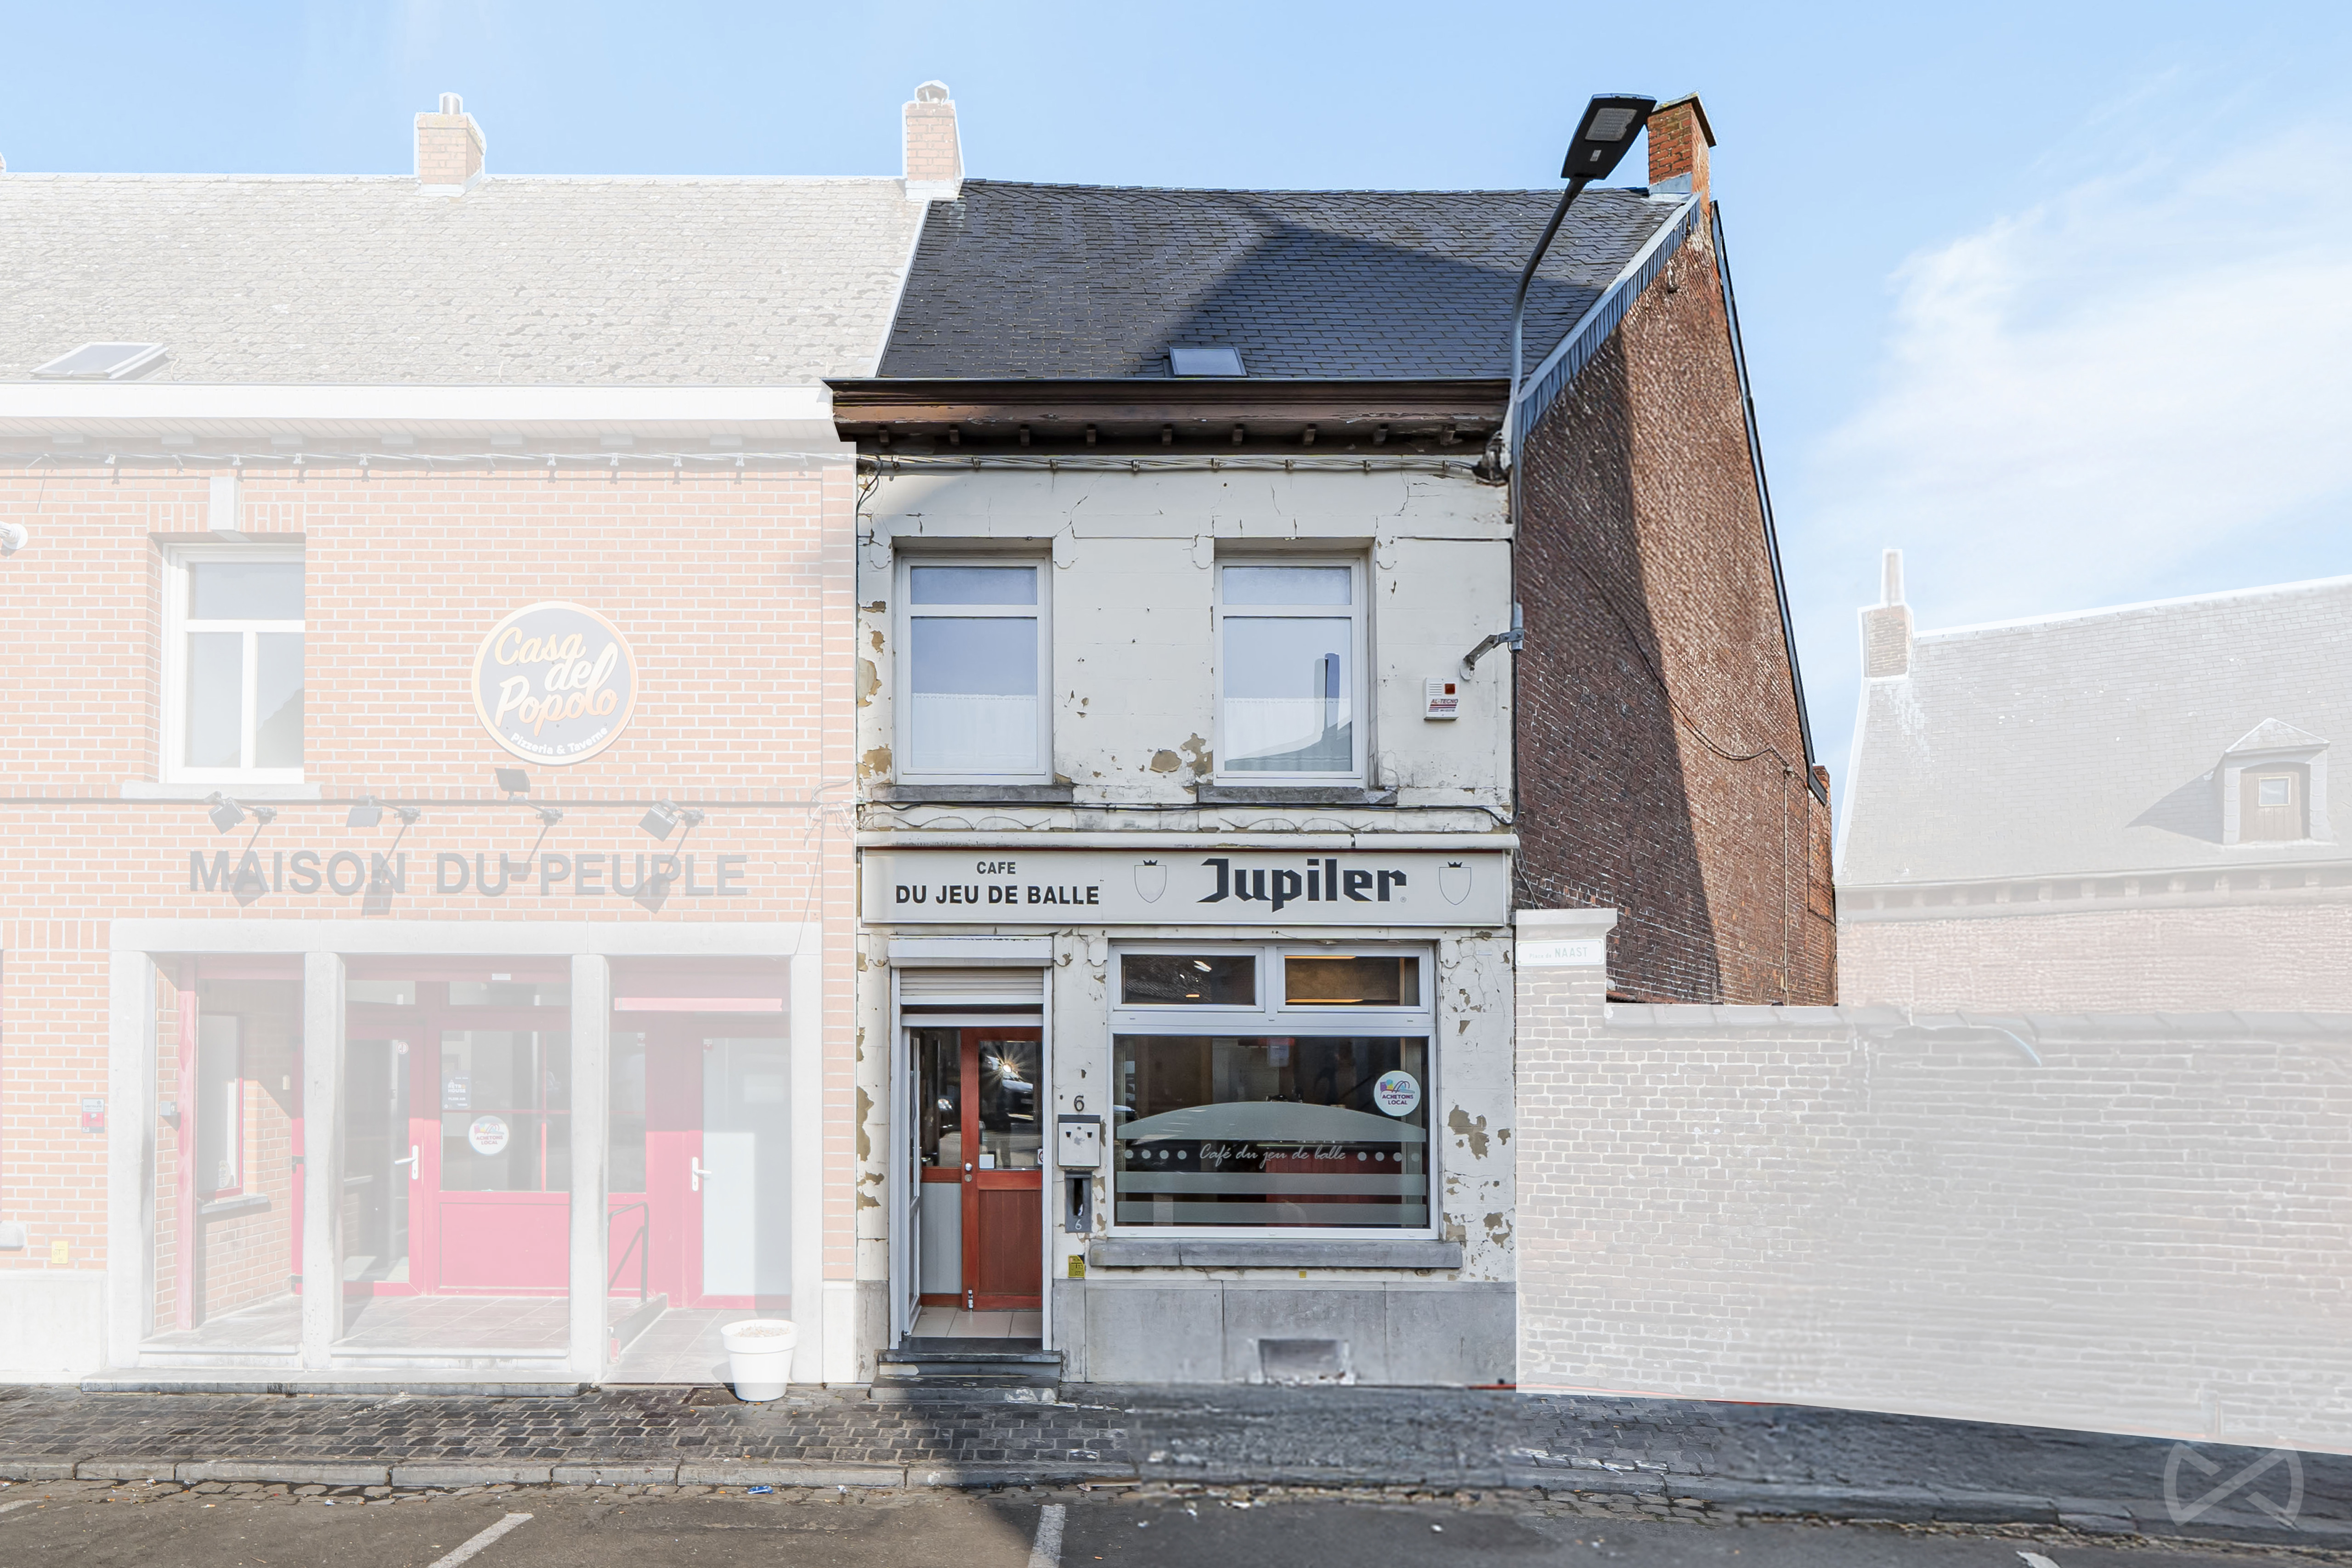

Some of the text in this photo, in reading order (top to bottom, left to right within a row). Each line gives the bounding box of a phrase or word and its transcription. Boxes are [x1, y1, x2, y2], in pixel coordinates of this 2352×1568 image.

[495, 627, 587, 665] Casa
[544, 642, 618, 691] del
[495, 675, 619, 737] Popolo
[510, 727, 608, 755] Pizzeria & Taverne
[190, 850, 748, 897] MAISON DU PEUPLE
[977, 861, 1016, 874] CAFE
[896, 885, 1099, 905] DU JEU DE BALLE
[1196, 858, 1407, 913] Jupiler
[1555, 947, 1588, 958] NAAST
[1074, 1095, 1085, 1112] 6
[1200, 1143, 1346, 1169] Café du jeu de balle
[1075, 1219, 1082, 1230] 6
